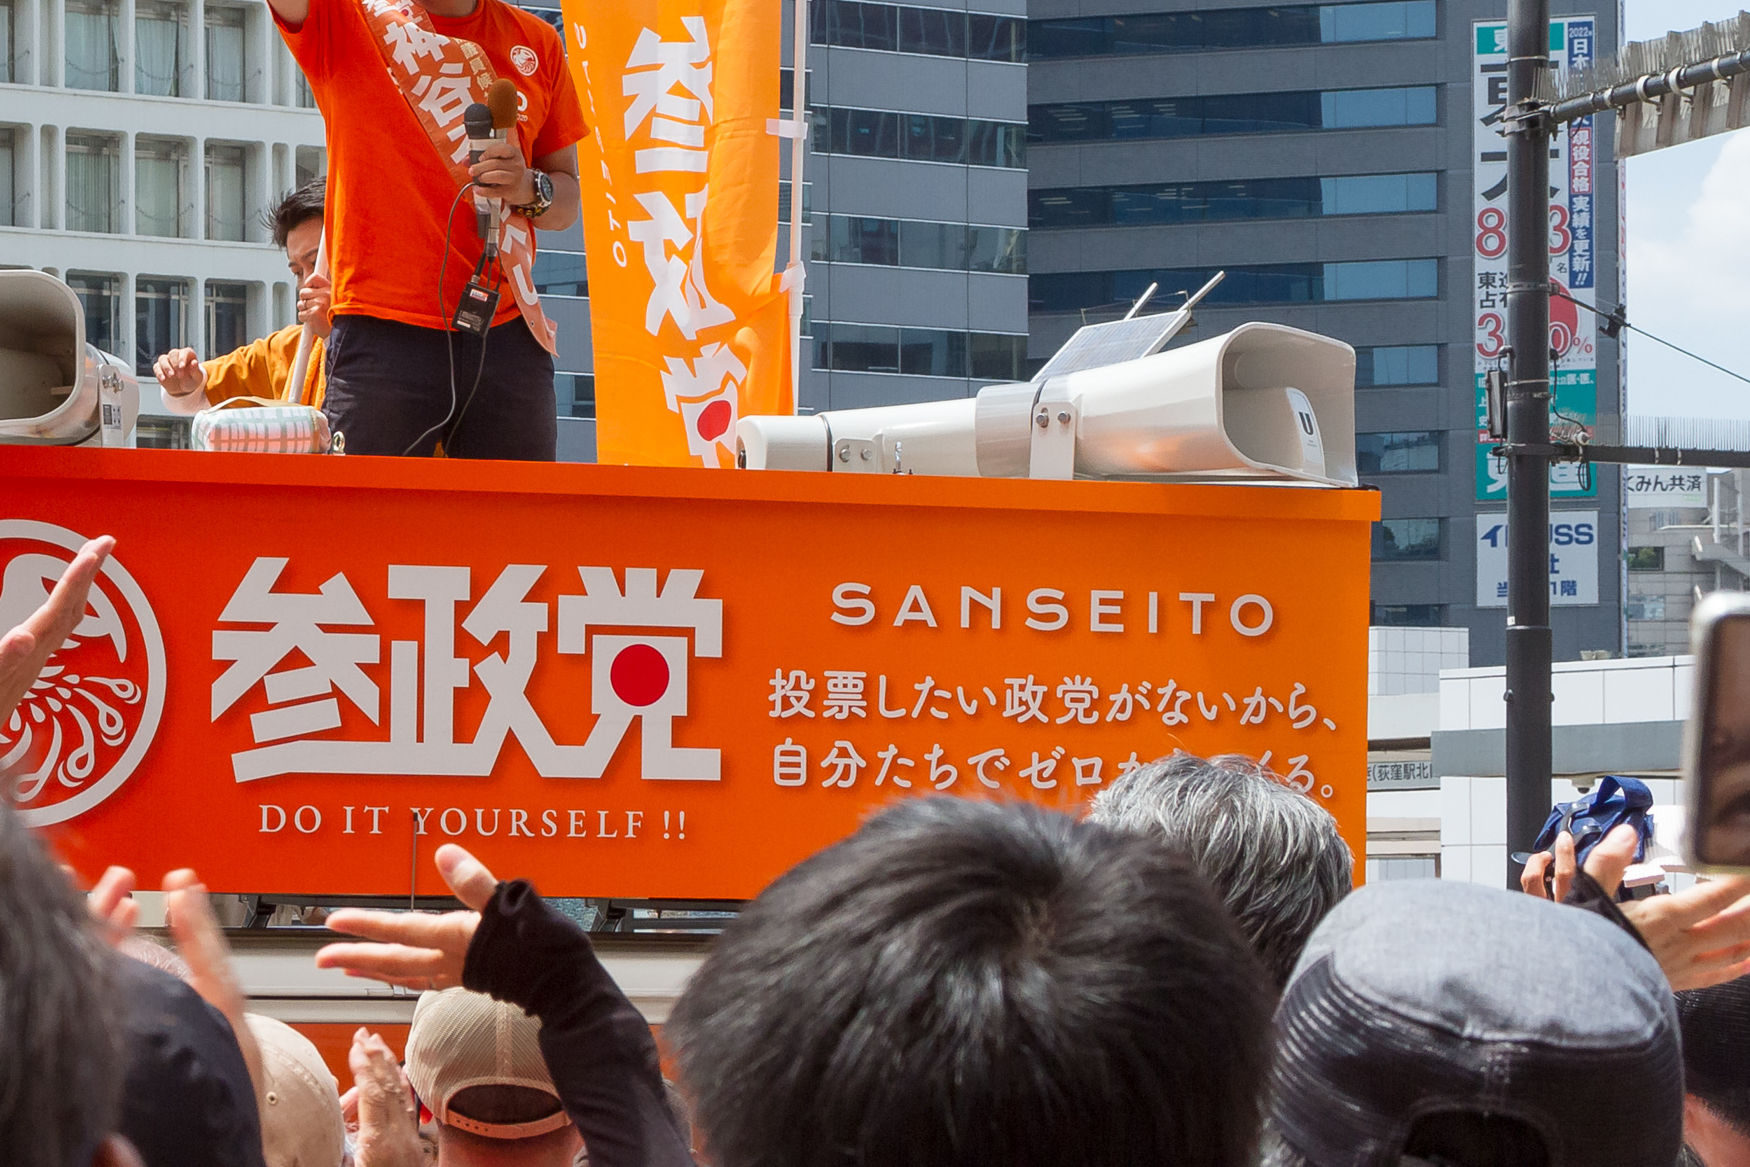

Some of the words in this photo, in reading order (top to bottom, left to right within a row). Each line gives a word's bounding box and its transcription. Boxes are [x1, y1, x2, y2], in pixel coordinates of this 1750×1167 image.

[830, 581, 1275, 638] SANSEITO
[210, 556, 724, 784] 参政党
[769, 668, 1338, 732] 投票したい政党がないから、
[258, 804, 323, 834] DO
[342, 805, 390, 835] IT
[410, 806, 646, 839] YOURSELF
